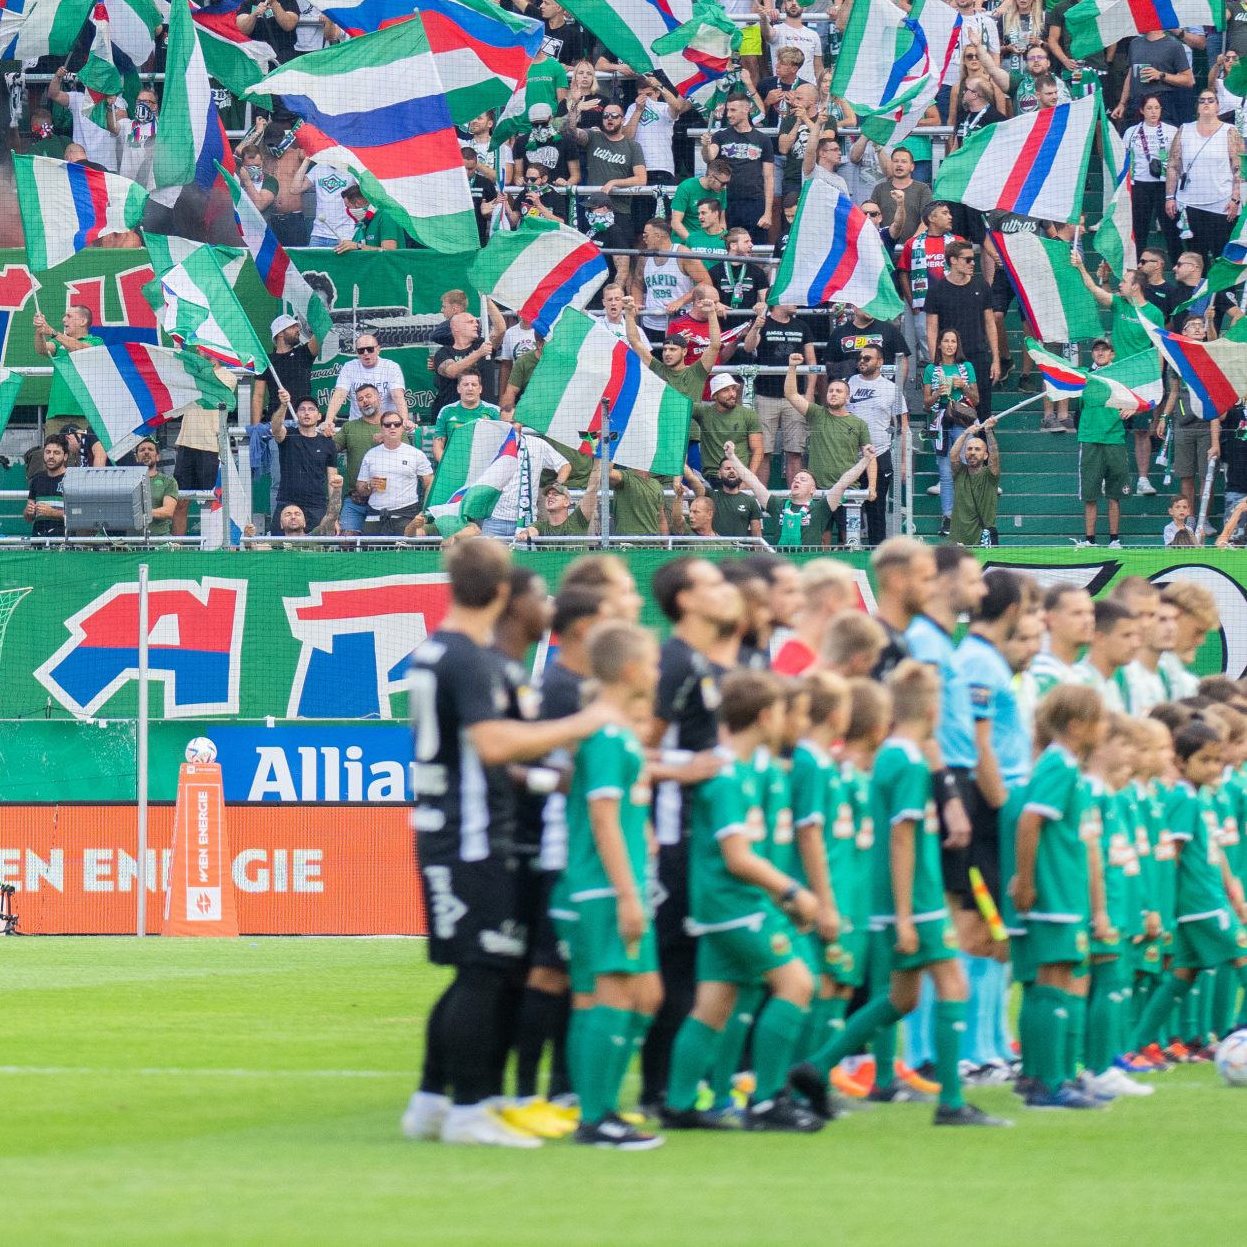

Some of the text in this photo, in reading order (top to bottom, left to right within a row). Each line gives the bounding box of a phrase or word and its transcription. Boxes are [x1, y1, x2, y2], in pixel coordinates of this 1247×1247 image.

[1001, 219, 1037, 234] ultras
[645, 273, 678, 289] RAPID
[854, 388, 877, 397] NIKE
[198, 791, 209, 882] WIEN ENERGIE
